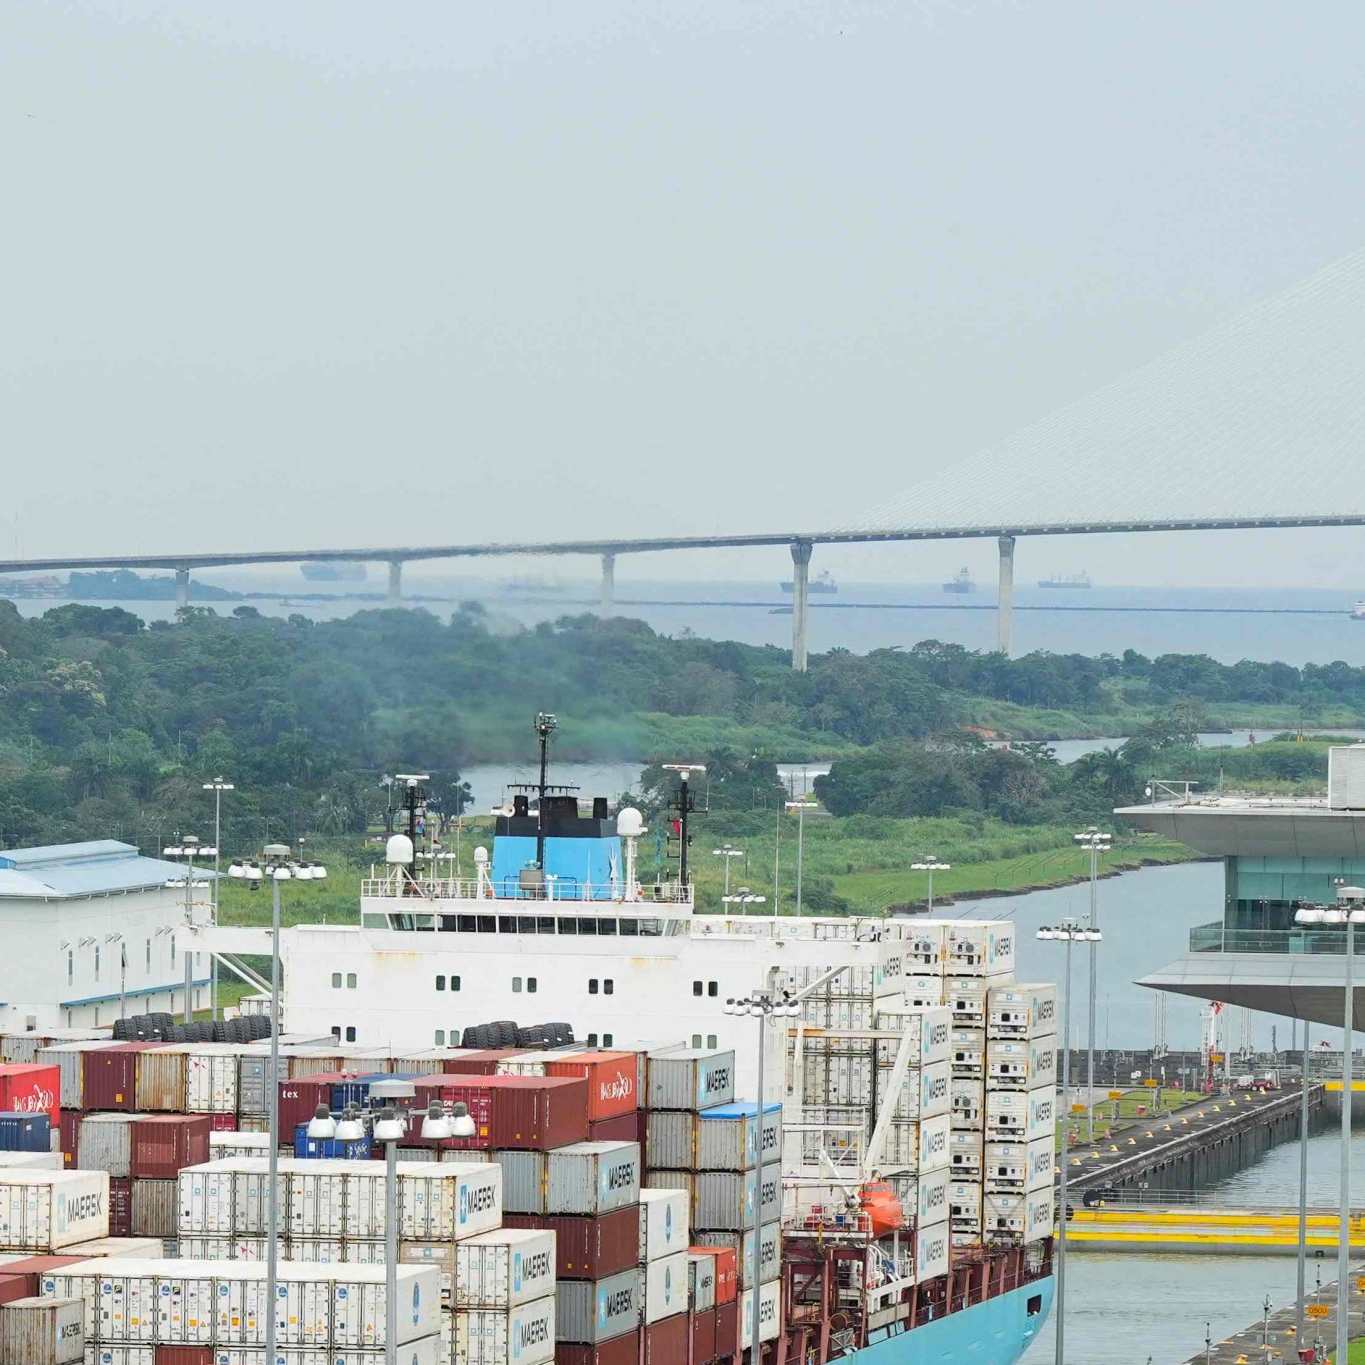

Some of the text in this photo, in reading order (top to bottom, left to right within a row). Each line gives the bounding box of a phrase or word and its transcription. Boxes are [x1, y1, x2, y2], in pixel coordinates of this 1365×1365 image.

[282, 1089, 298, 1099] tex
[706, 1067, 731, 1093] MAERSK
[609, 1161, 635, 1191] MAERSK
[67, 1191, 102, 1223] MAERSK
[467, 1184, 496, 1215] MAERSK
[522, 1251, 551, 1282] MAERSK
[606, 1288, 633, 1318] MAERSK
[521, 1317, 549, 1348] MAERSK
